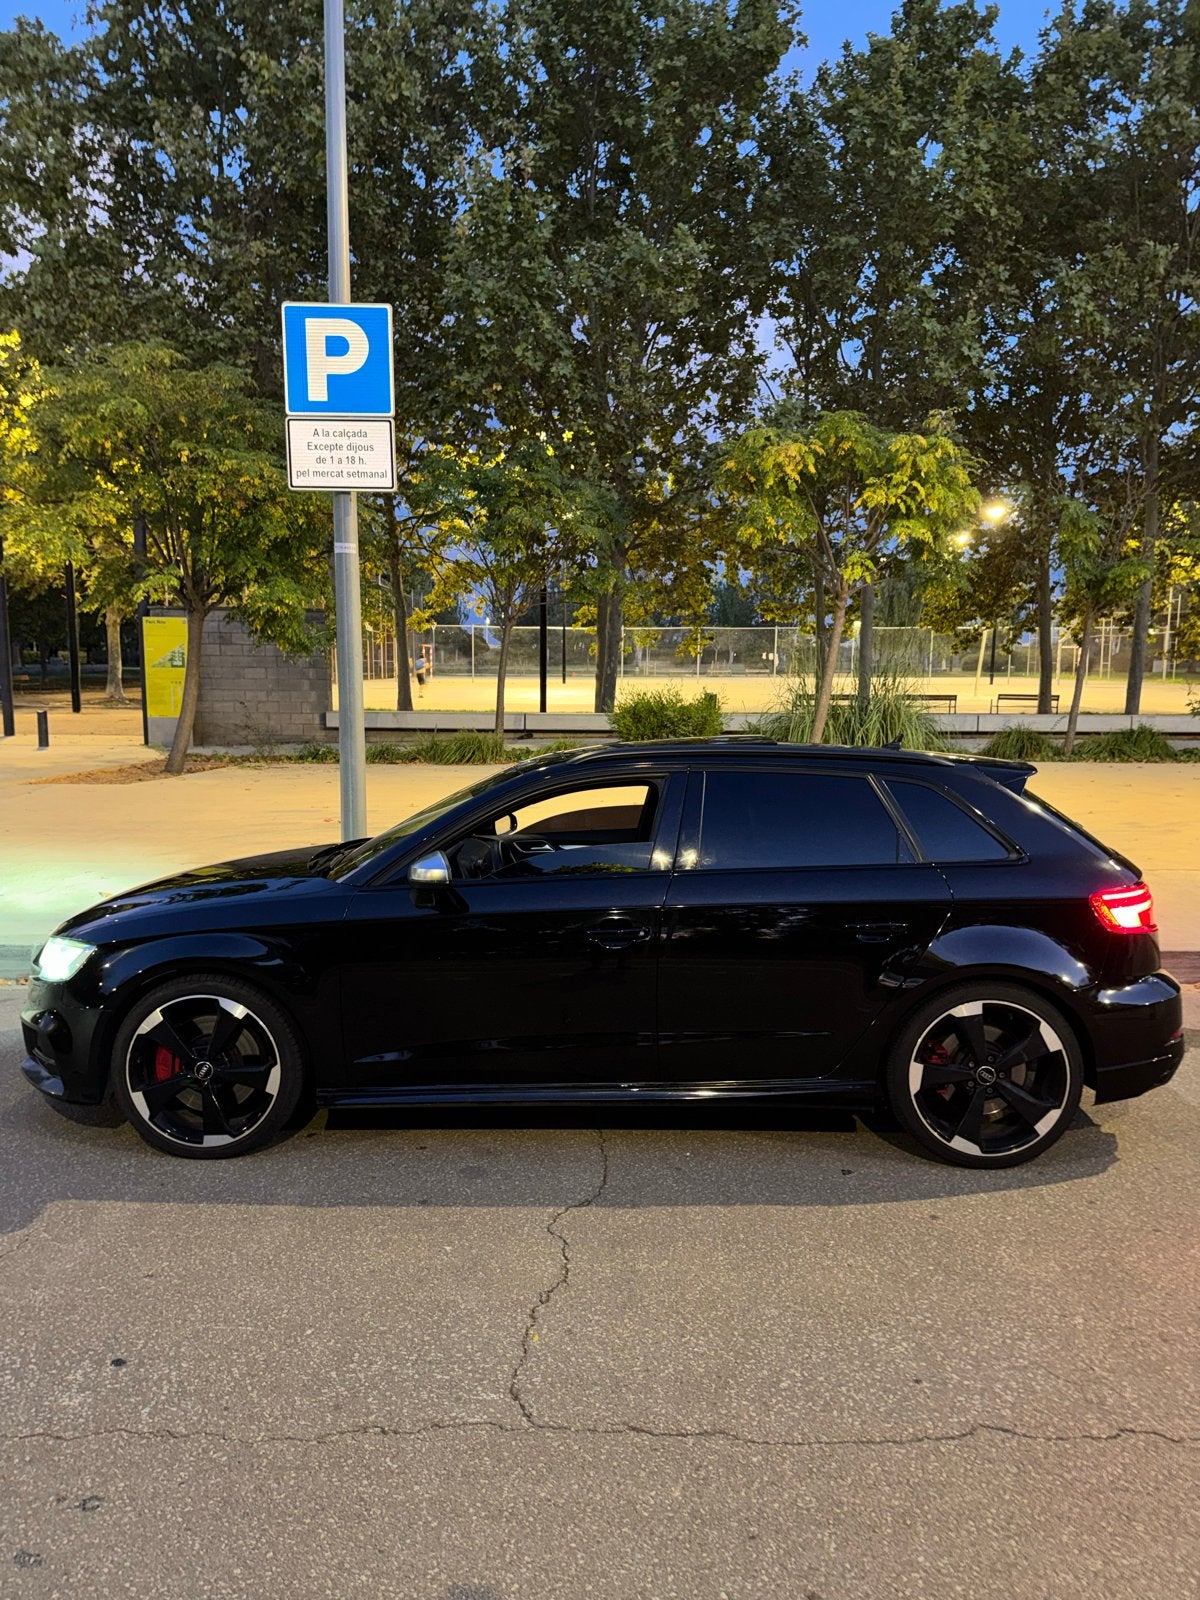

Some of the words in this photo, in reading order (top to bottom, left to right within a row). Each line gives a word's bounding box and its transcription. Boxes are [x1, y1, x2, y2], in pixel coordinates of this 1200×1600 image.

[305, 317, 370, 402] P
[312, 428, 320, 437] A
[322, 428, 330, 437] la
[332, 428, 368, 439] calçada
[307, 442, 344, 453] Excepte
[346, 442, 375, 453] dijous
[315, 455, 327, 465] de
[330, 455, 334, 464] 1
[337, 457, 343, 465] a
[345, 455, 356, 465] 18
[358, 456, 367, 464] h.
[296, 468, 310, 480] pel
[312, 469, 344, 478] mercat
[346, 469, 388, 479] setmanal
